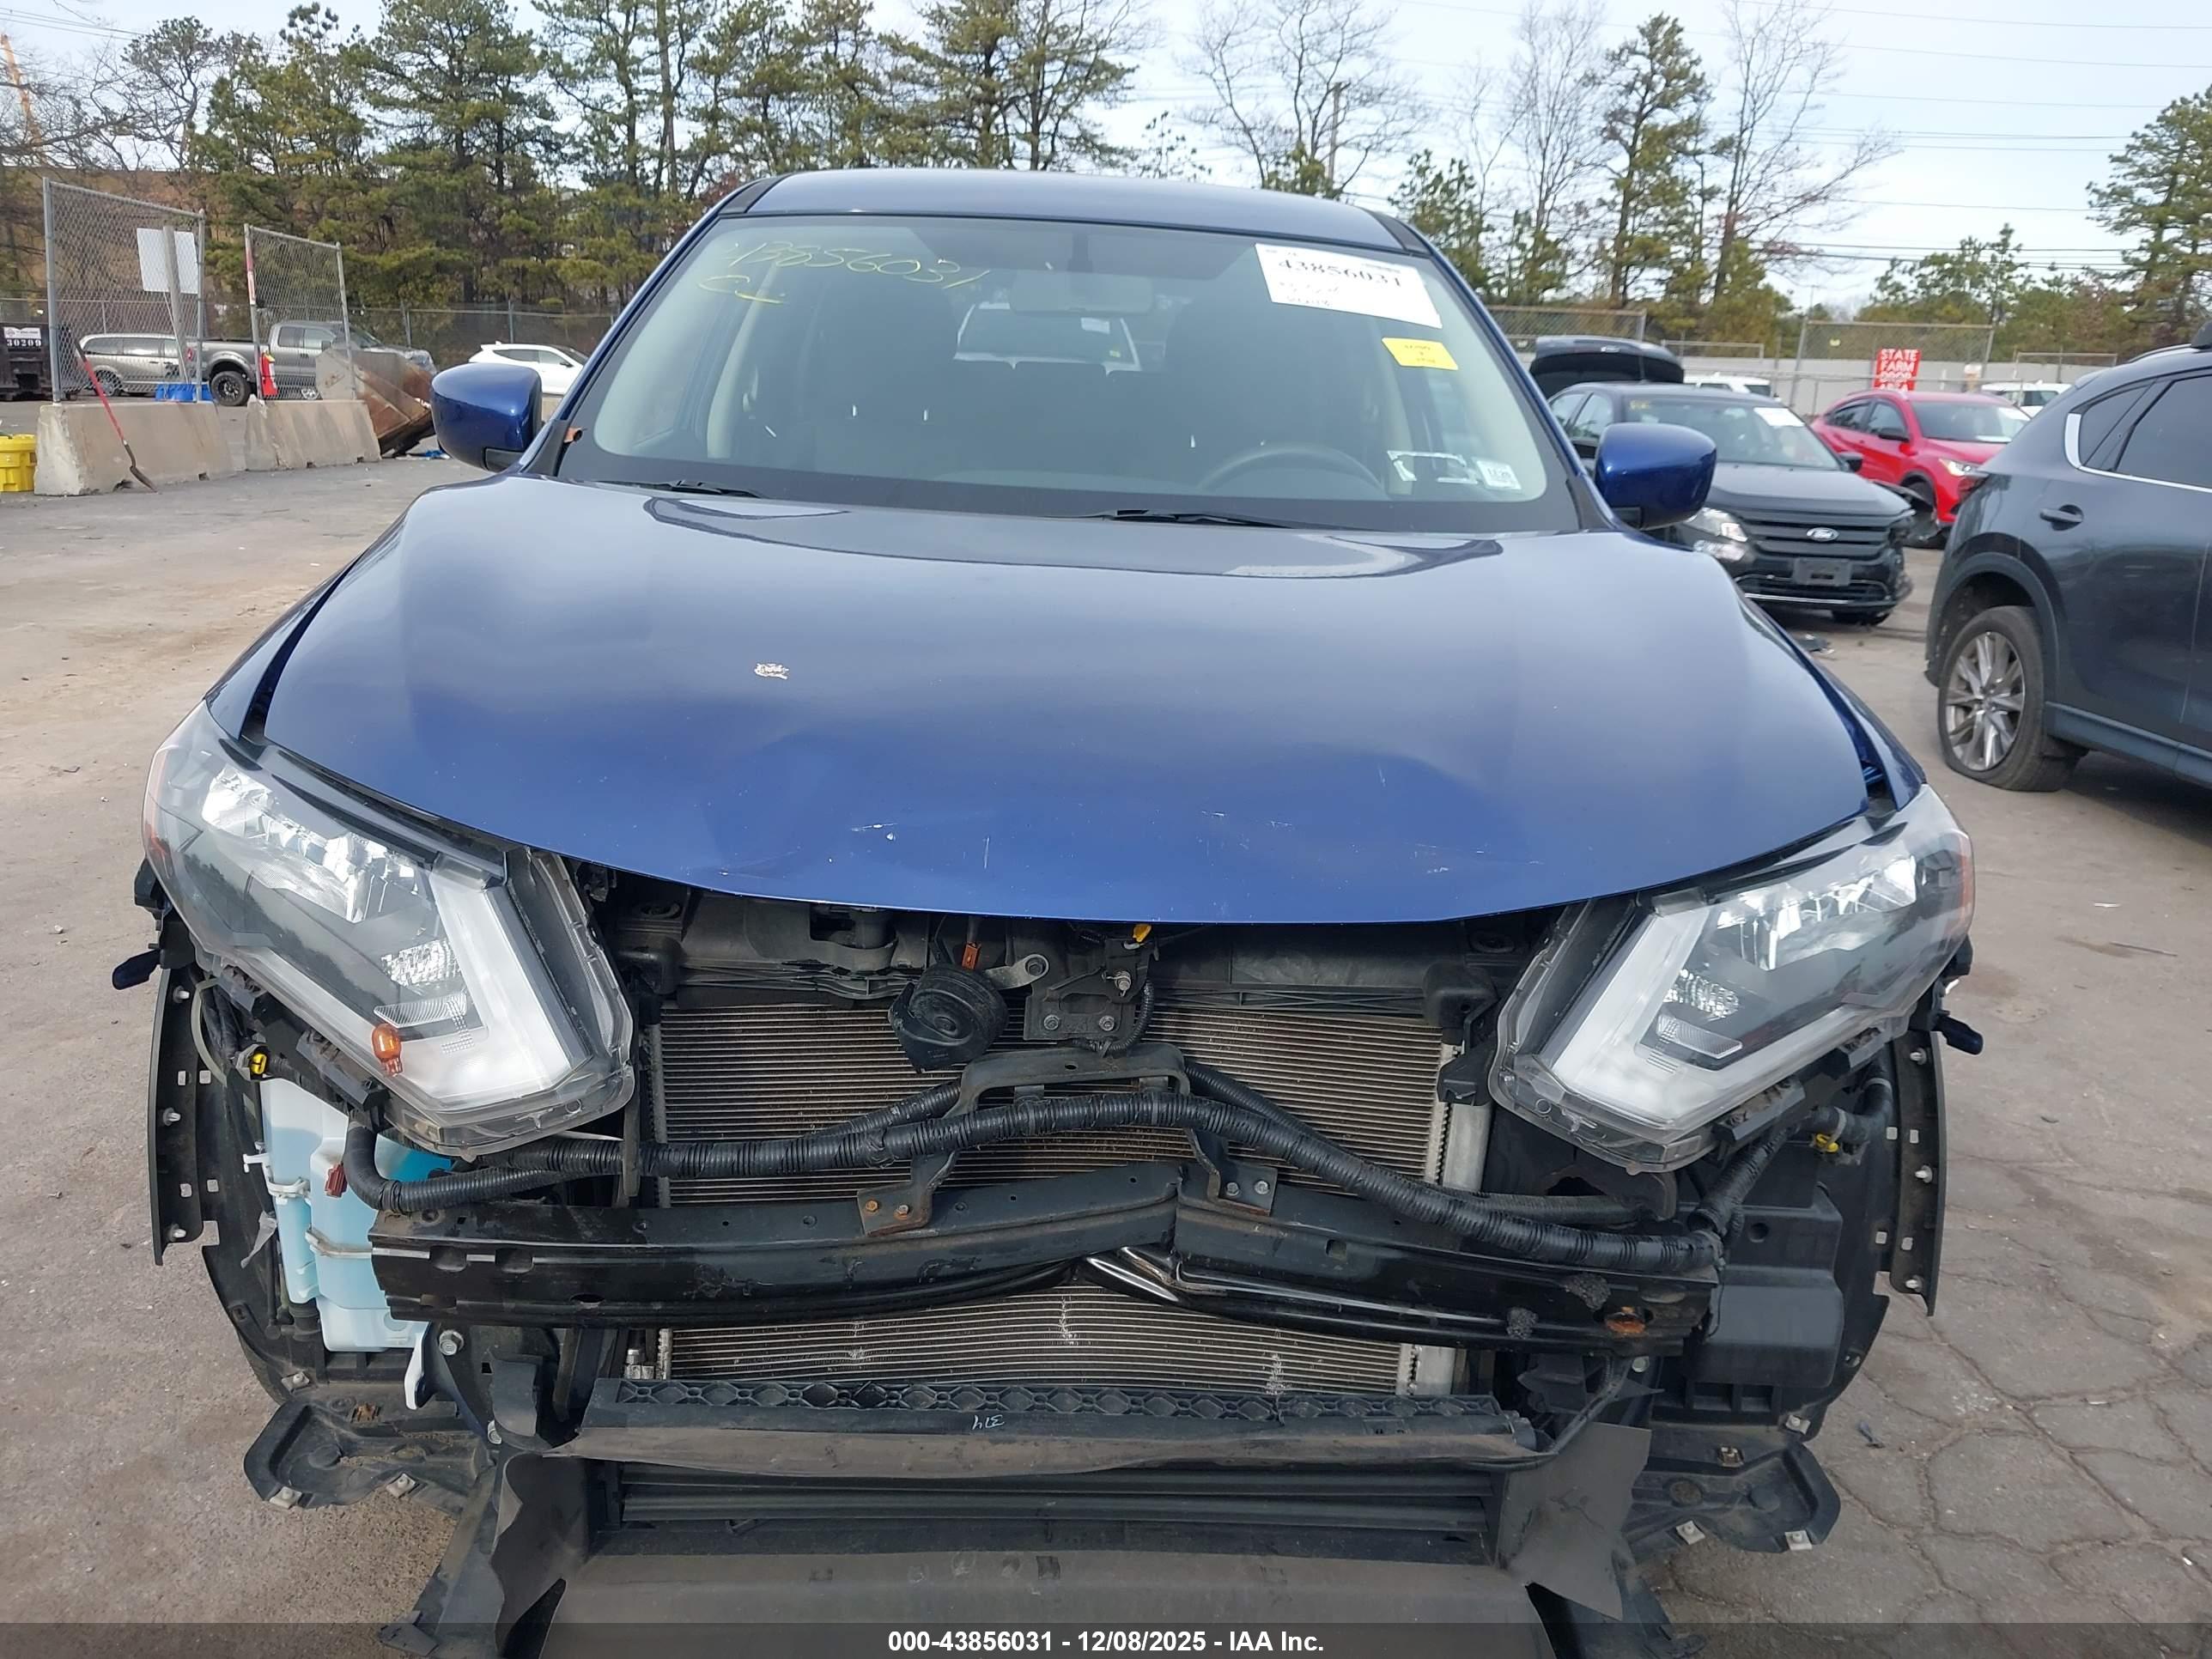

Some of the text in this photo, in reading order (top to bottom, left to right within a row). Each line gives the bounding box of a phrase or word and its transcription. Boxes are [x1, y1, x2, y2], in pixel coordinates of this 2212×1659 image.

[1278, 258, 1401, 287] 43856031
[1881, 349, 1917, 362] STATE
[1880, 361, 1915, 372] FARM
